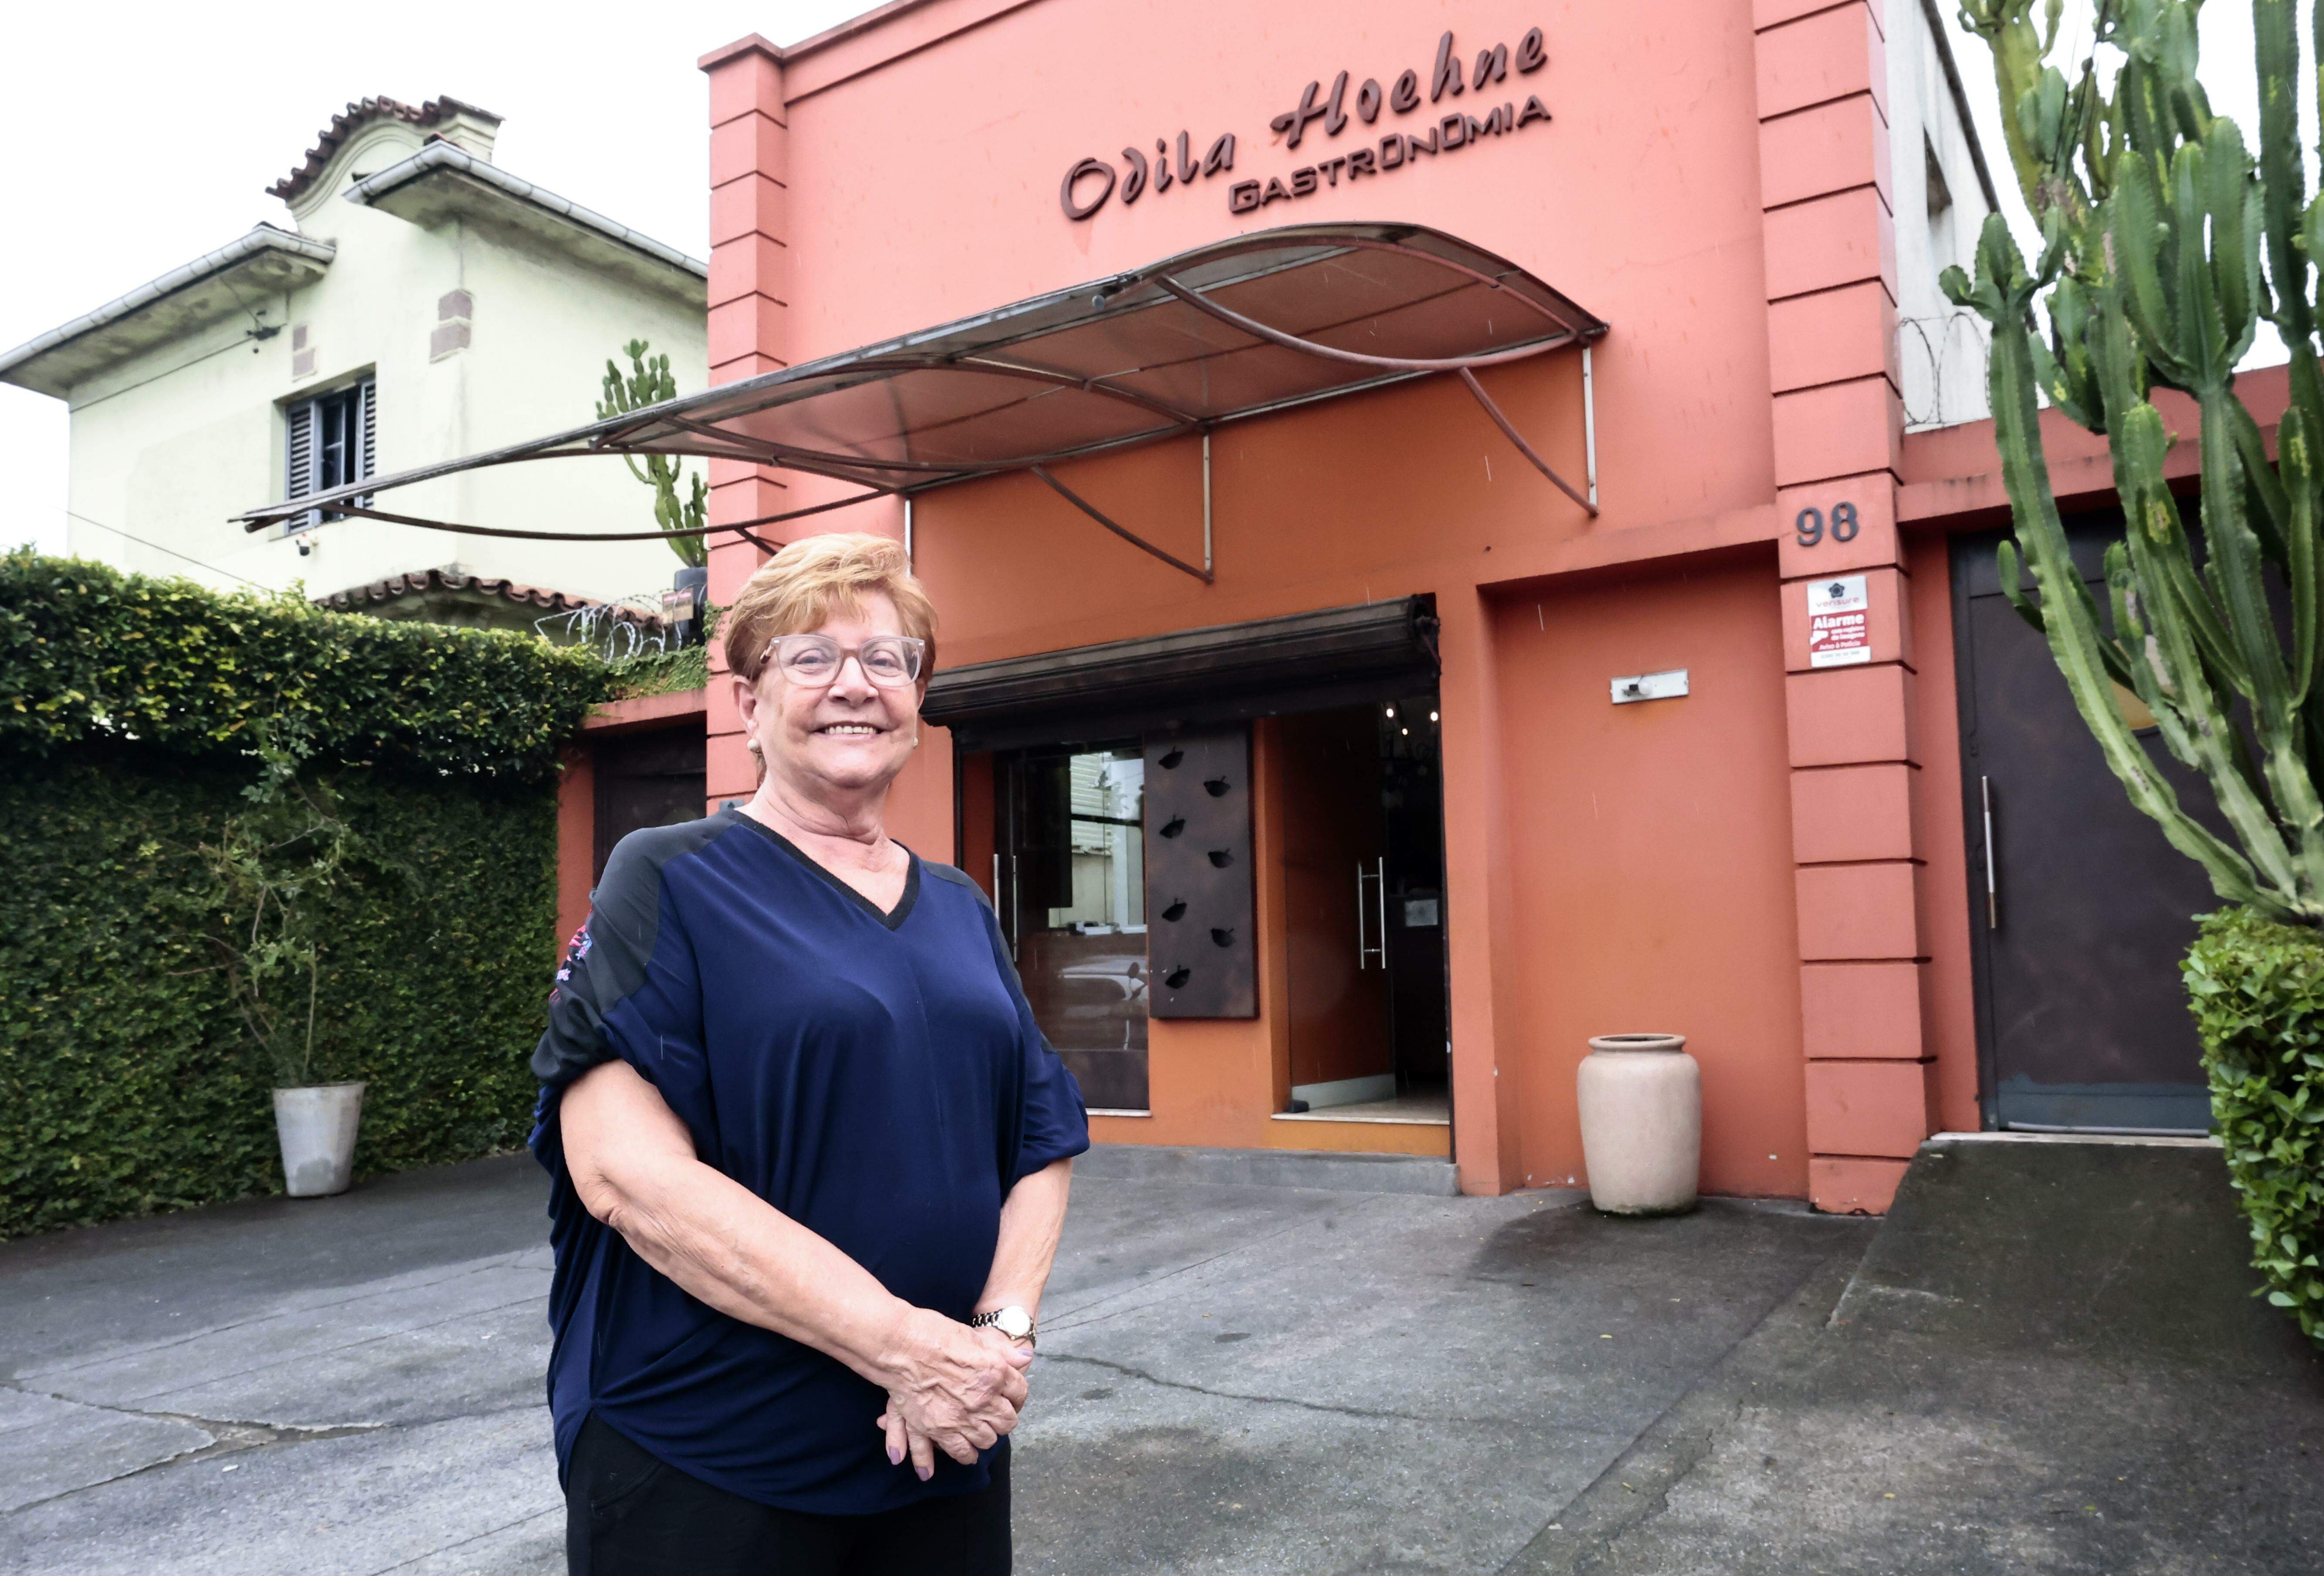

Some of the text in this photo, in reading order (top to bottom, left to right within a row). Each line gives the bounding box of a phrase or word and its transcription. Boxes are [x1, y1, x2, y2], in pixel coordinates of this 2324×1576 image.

[1060, 27, 1549, 219] Odila Hoehne
[1228, 94, 1553, 214] GASTRONOMIA
[1796, 502, 1859, 548] 98
[1813, 614, 1865, 630] Alarme
